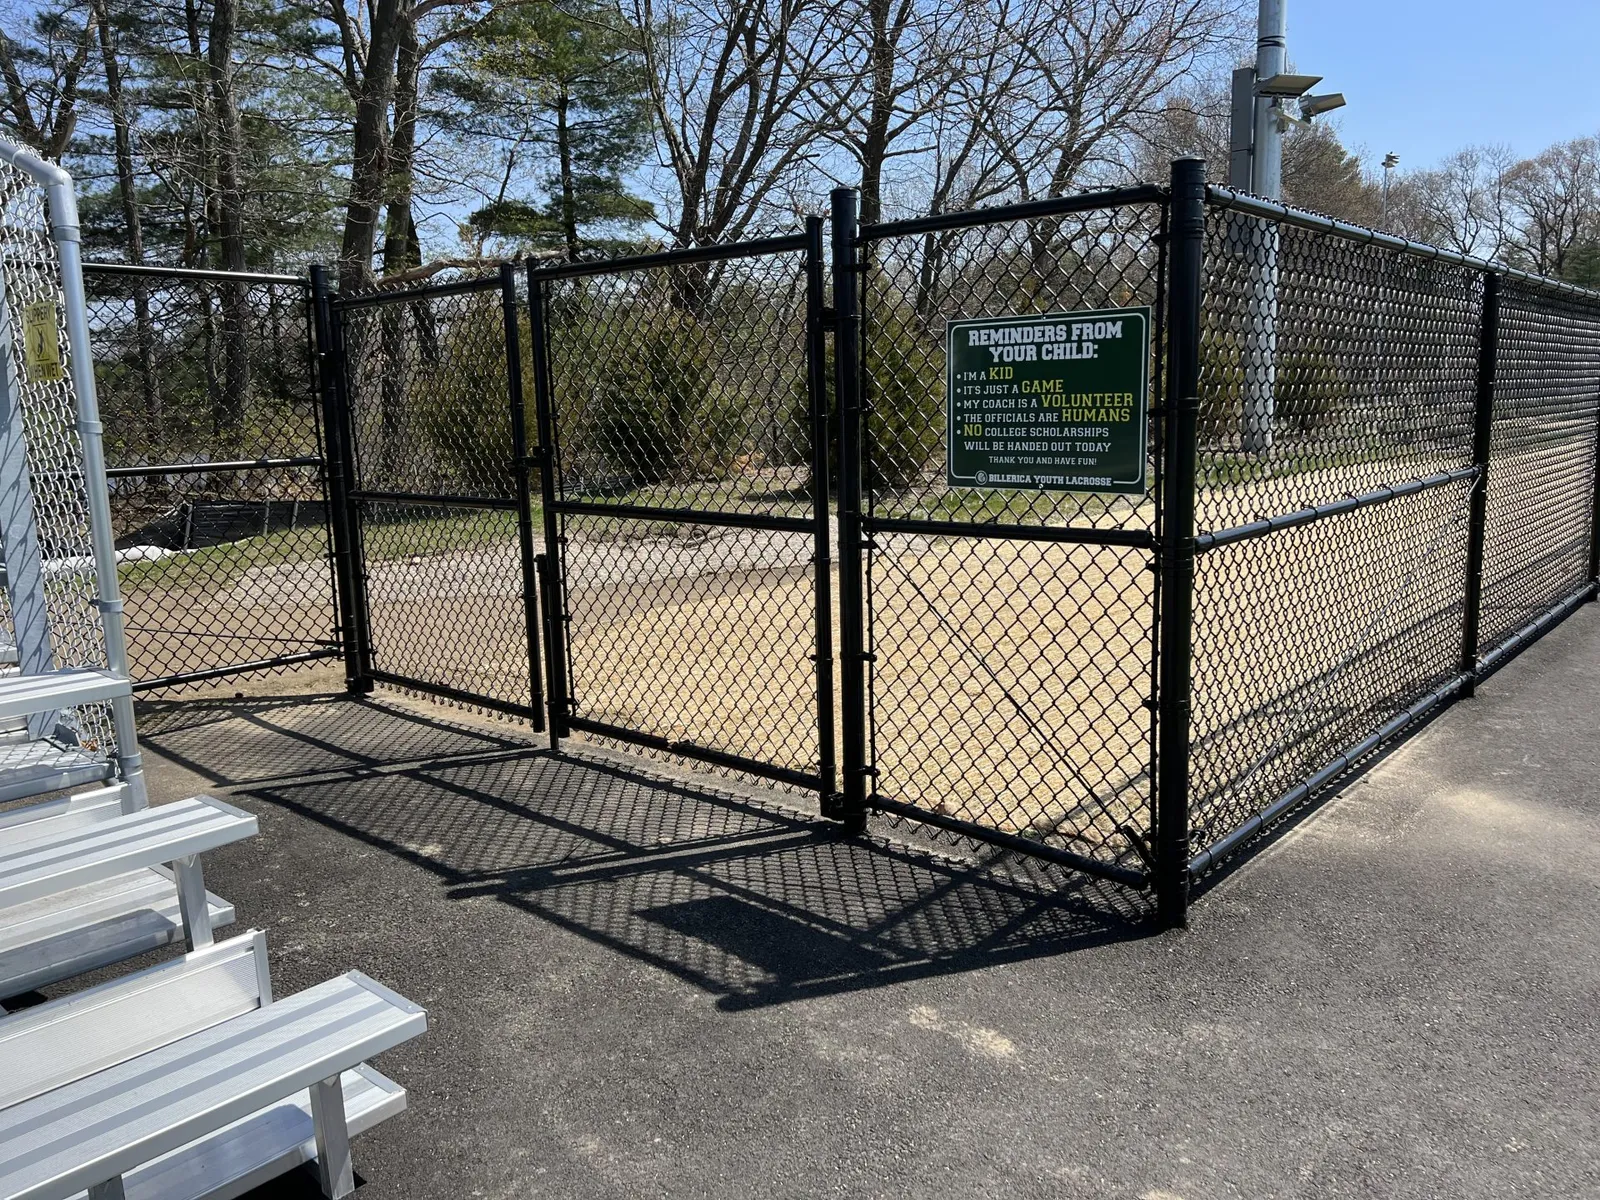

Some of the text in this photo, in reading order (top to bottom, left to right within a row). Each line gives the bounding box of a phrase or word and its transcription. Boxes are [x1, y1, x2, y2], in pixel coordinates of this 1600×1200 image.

[969, 321, 1123, 346] REMINDERS FROM
[989, 342, 1098, 363] YOUR CHILD:
[963, 367, 1013, 381] I'M A KID
[963, 380, 1064, 395] IT'S JUST A GAME
[963, 393, 1133, 409] MY COACH IS A VOLUNTEER
[964, 409, 1130, 423] THE OFFICIALS ARE HUMANS
[963, 424, 1109, 437] NO COLLEGE SCHOLARSHIPS
[964, 442, 1111, 452] WILL BE HANDED OUT TODAY
[989, 456, 1015, 464] THANK
[1018, 456, 1034, 464] YOU
[1036, 457, 1053, 465] AND
[1054, 457, 1076, 465] HAVE
[989, 473, 1112, 486] BILLERICA YOUTH LACROSSE
